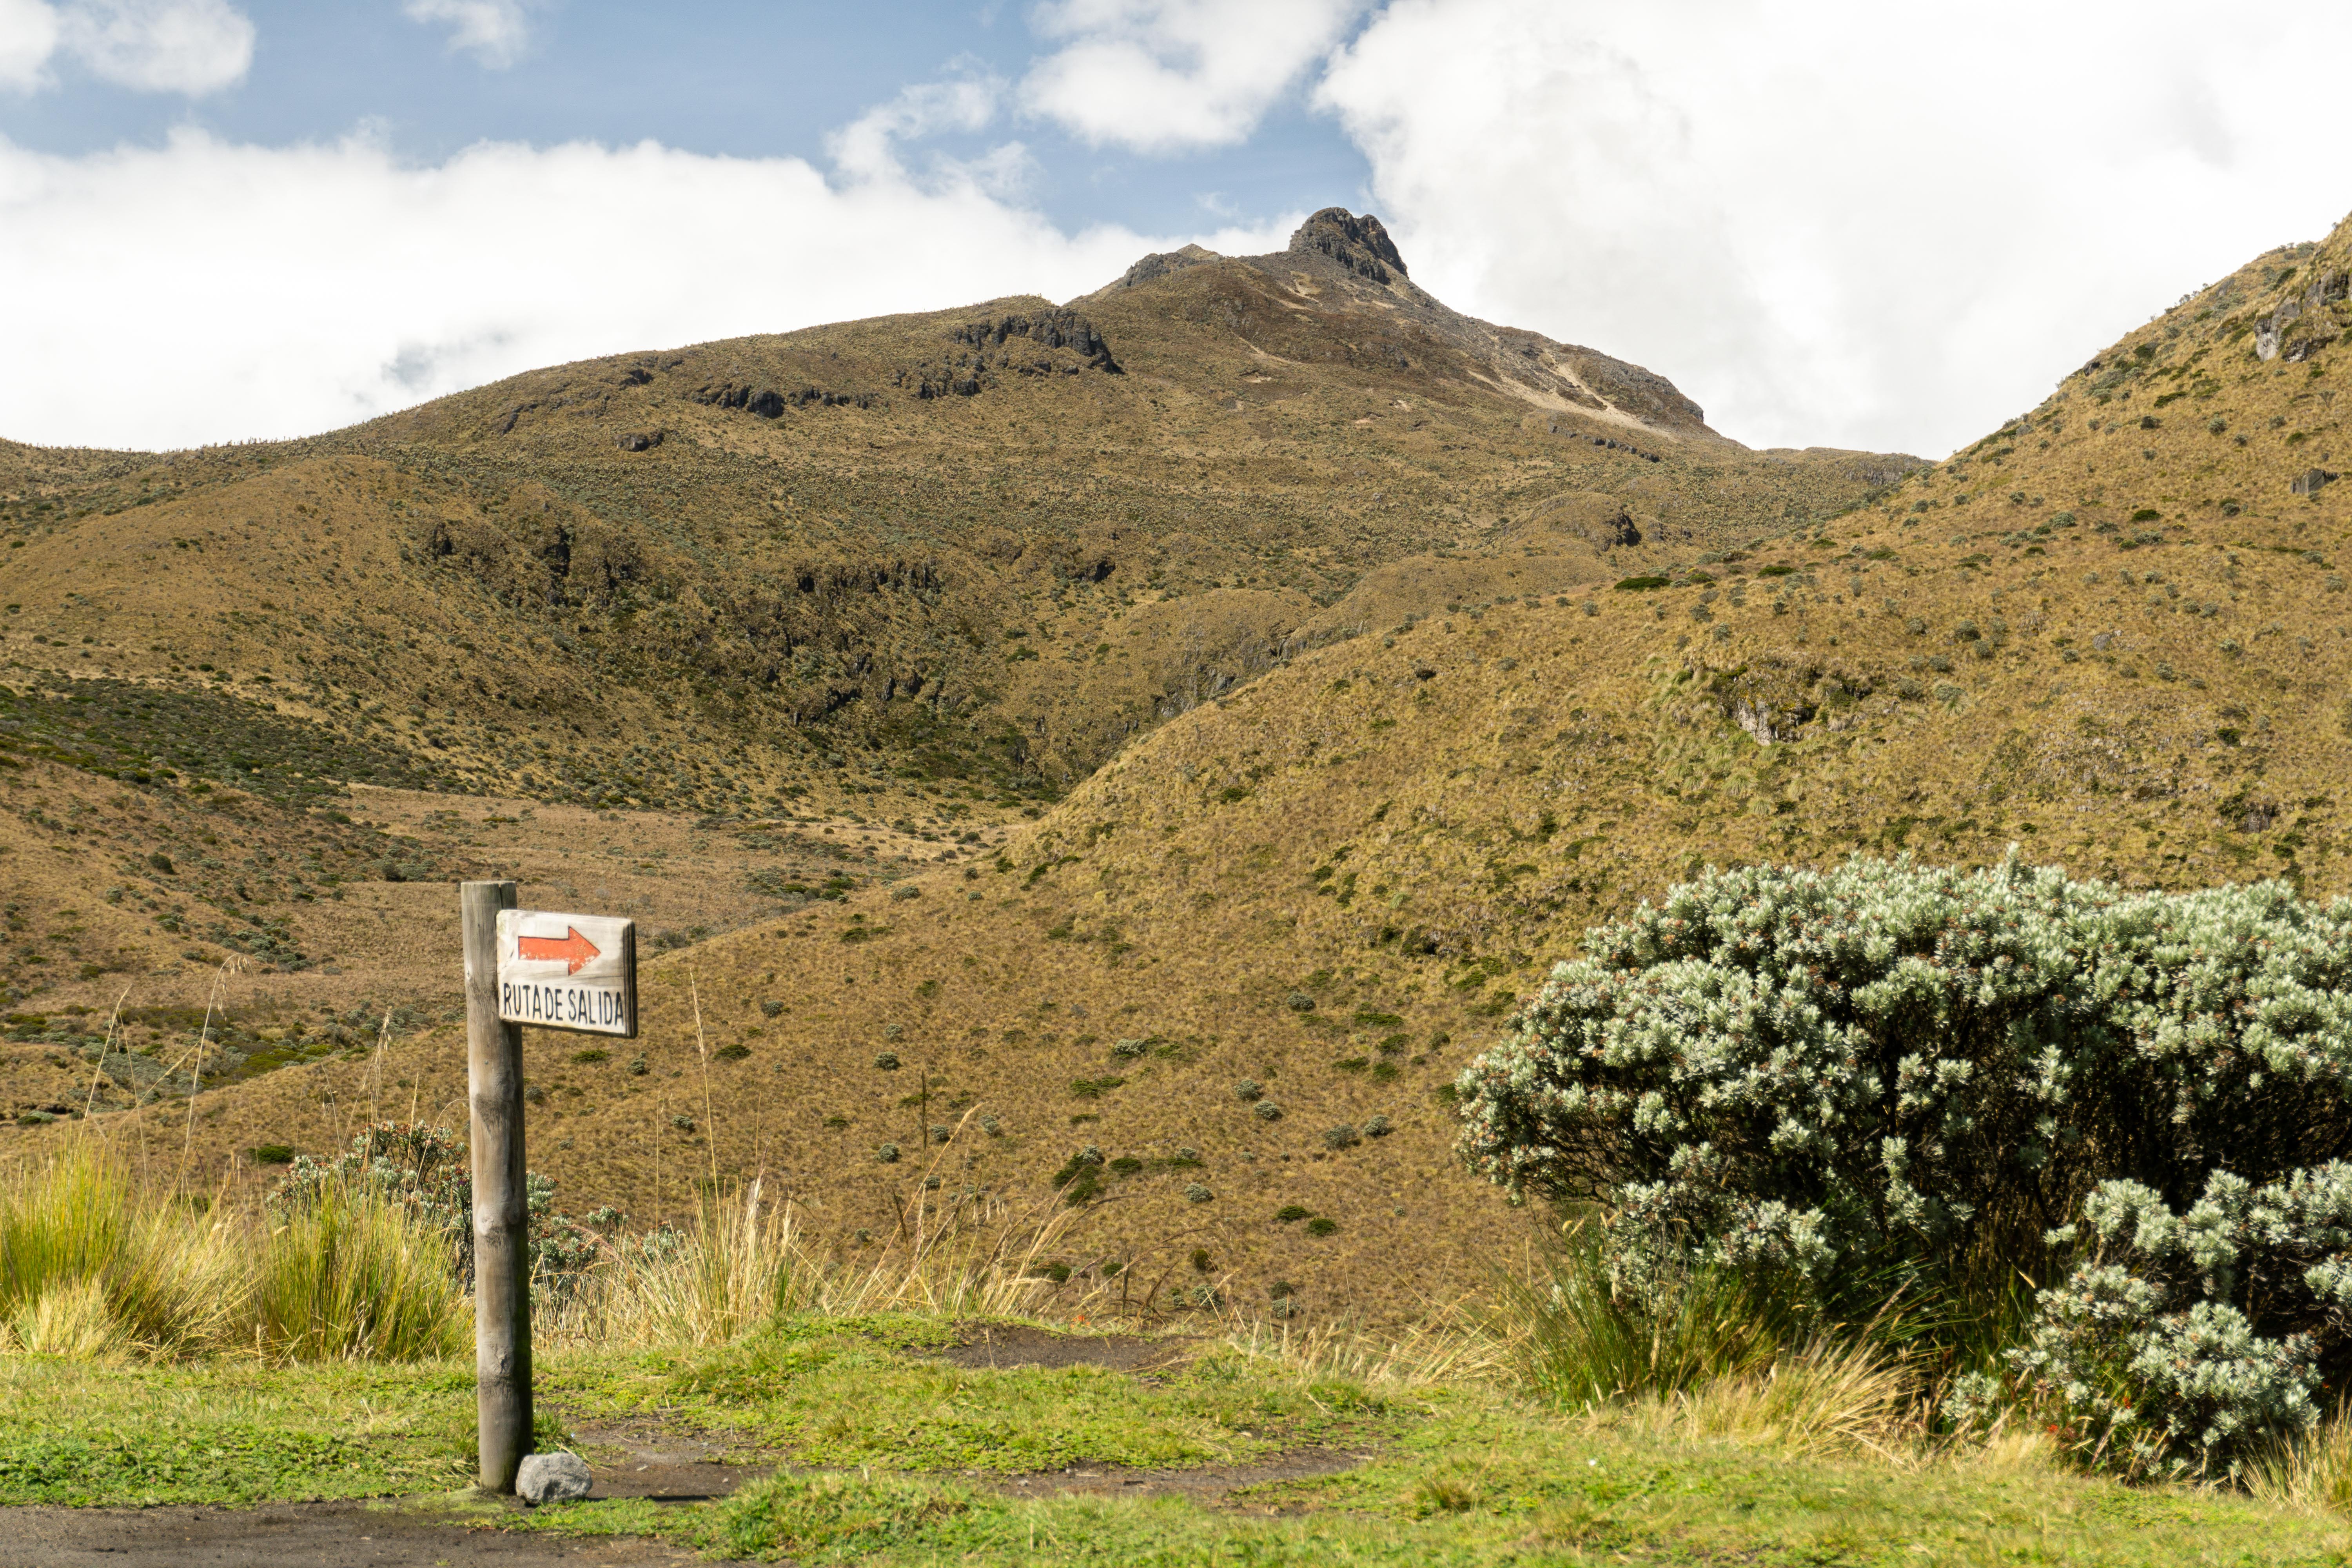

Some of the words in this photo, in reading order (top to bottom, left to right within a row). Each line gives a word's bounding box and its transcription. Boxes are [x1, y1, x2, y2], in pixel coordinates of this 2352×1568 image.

[504, 983, 542, 1020] RUTA
[545, 987, 563, 1021] DE
[568, 989, 624, 1026] SALIDA
